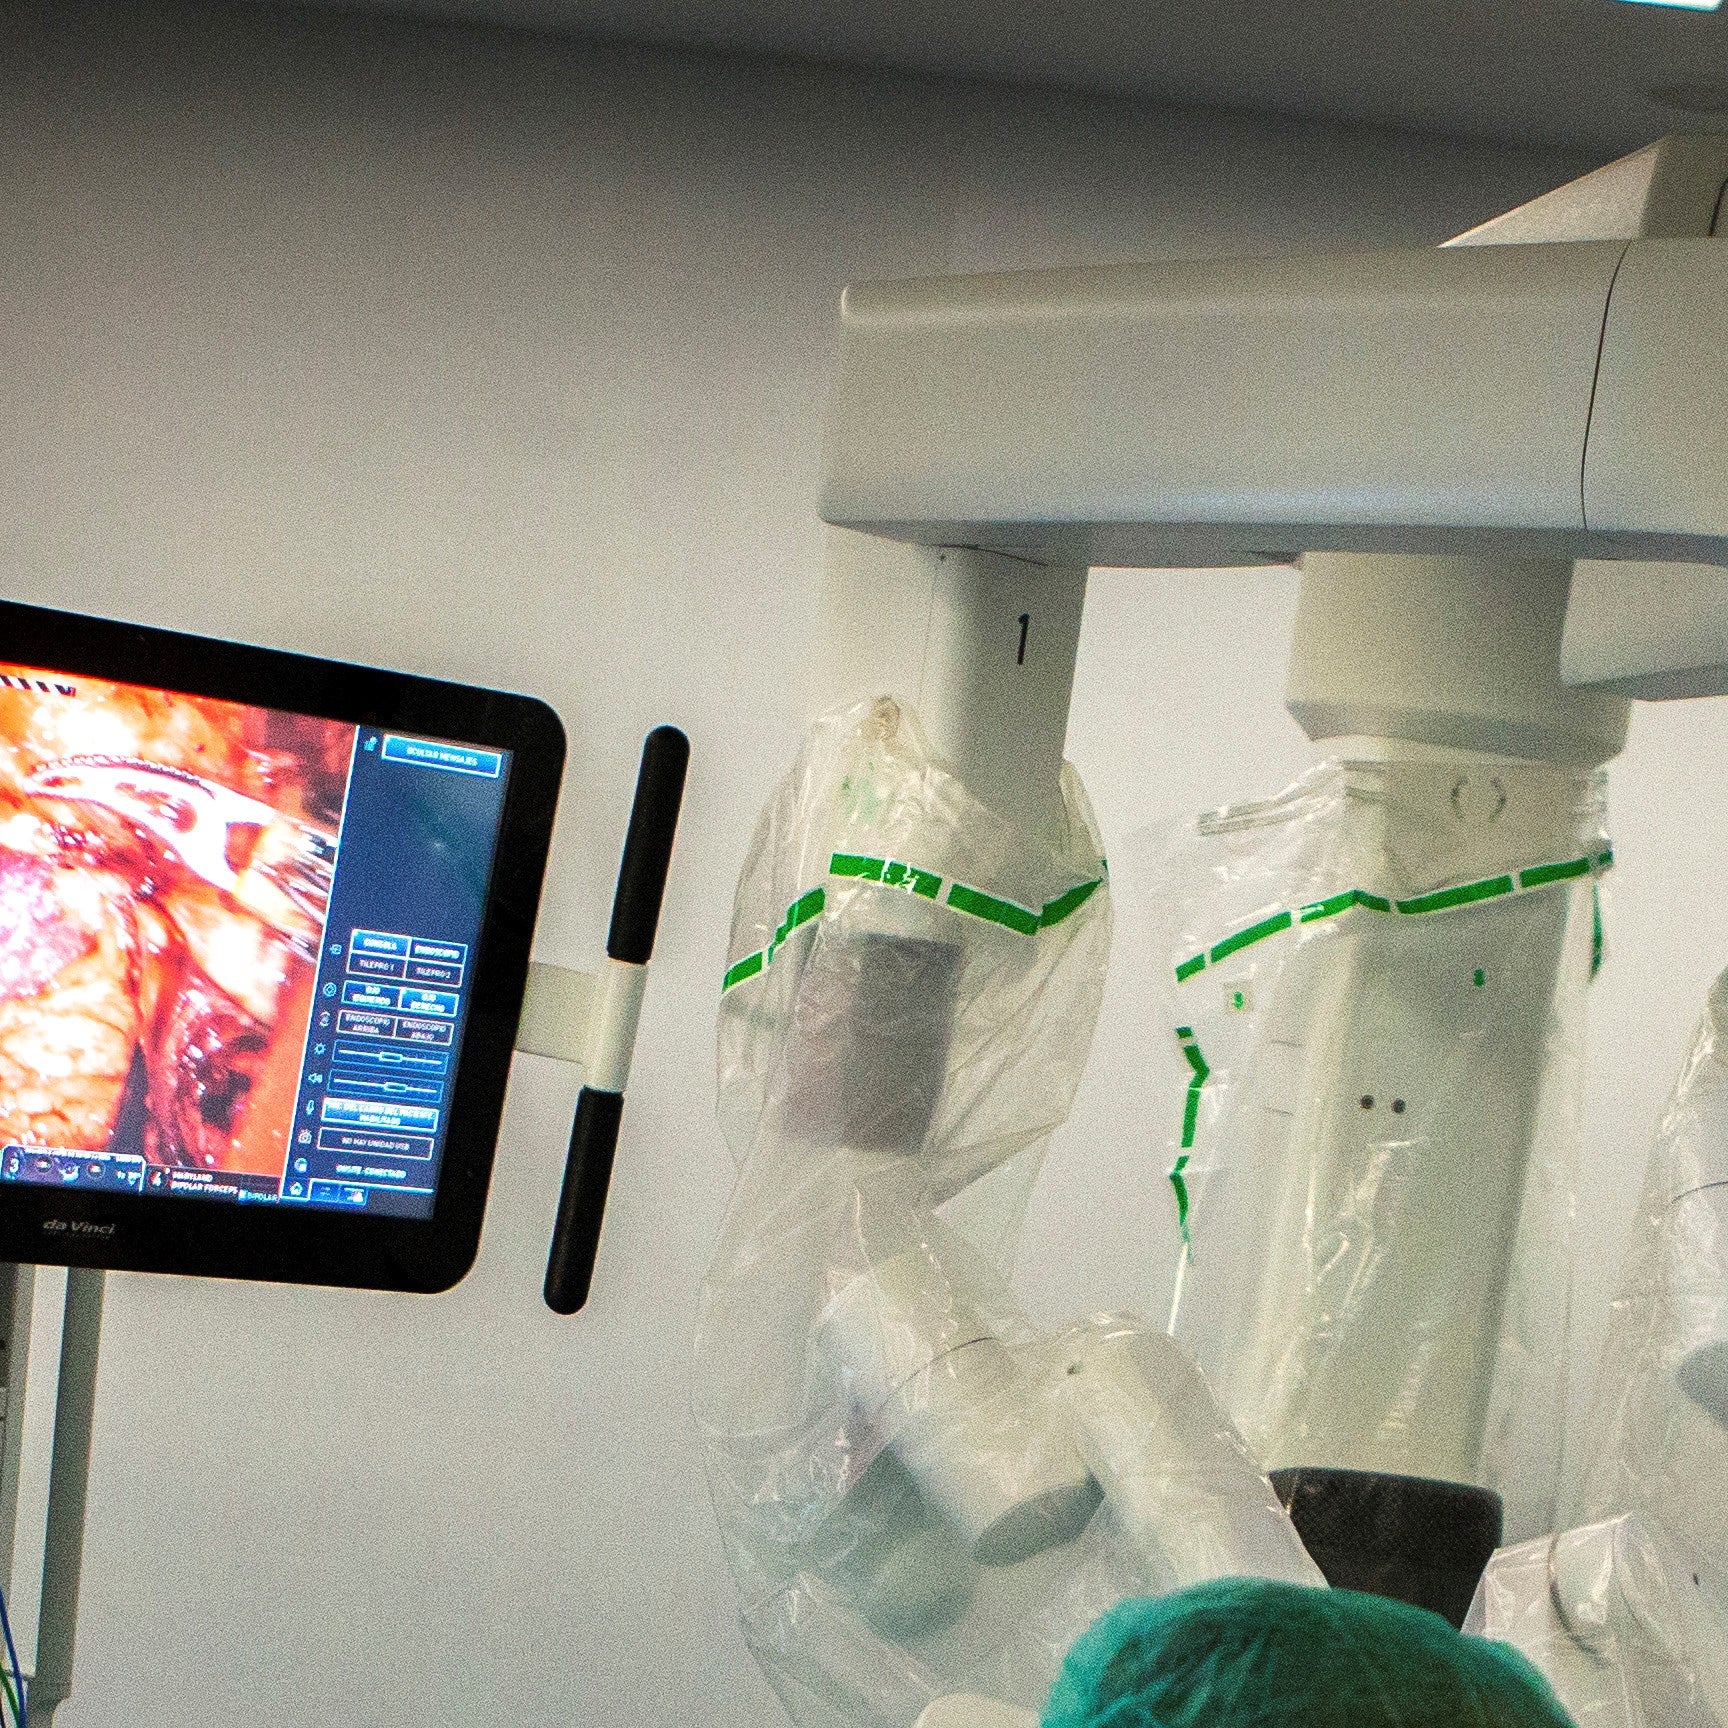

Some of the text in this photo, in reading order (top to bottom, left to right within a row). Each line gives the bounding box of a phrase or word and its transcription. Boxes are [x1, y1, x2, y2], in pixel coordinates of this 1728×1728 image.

[1015, 612, 1030, 667] 1
[9, 1158, 20, 1173] 3
[150, 1171, 162, 1187] 4
[42, 1219, 116, 1234] da Vinci
